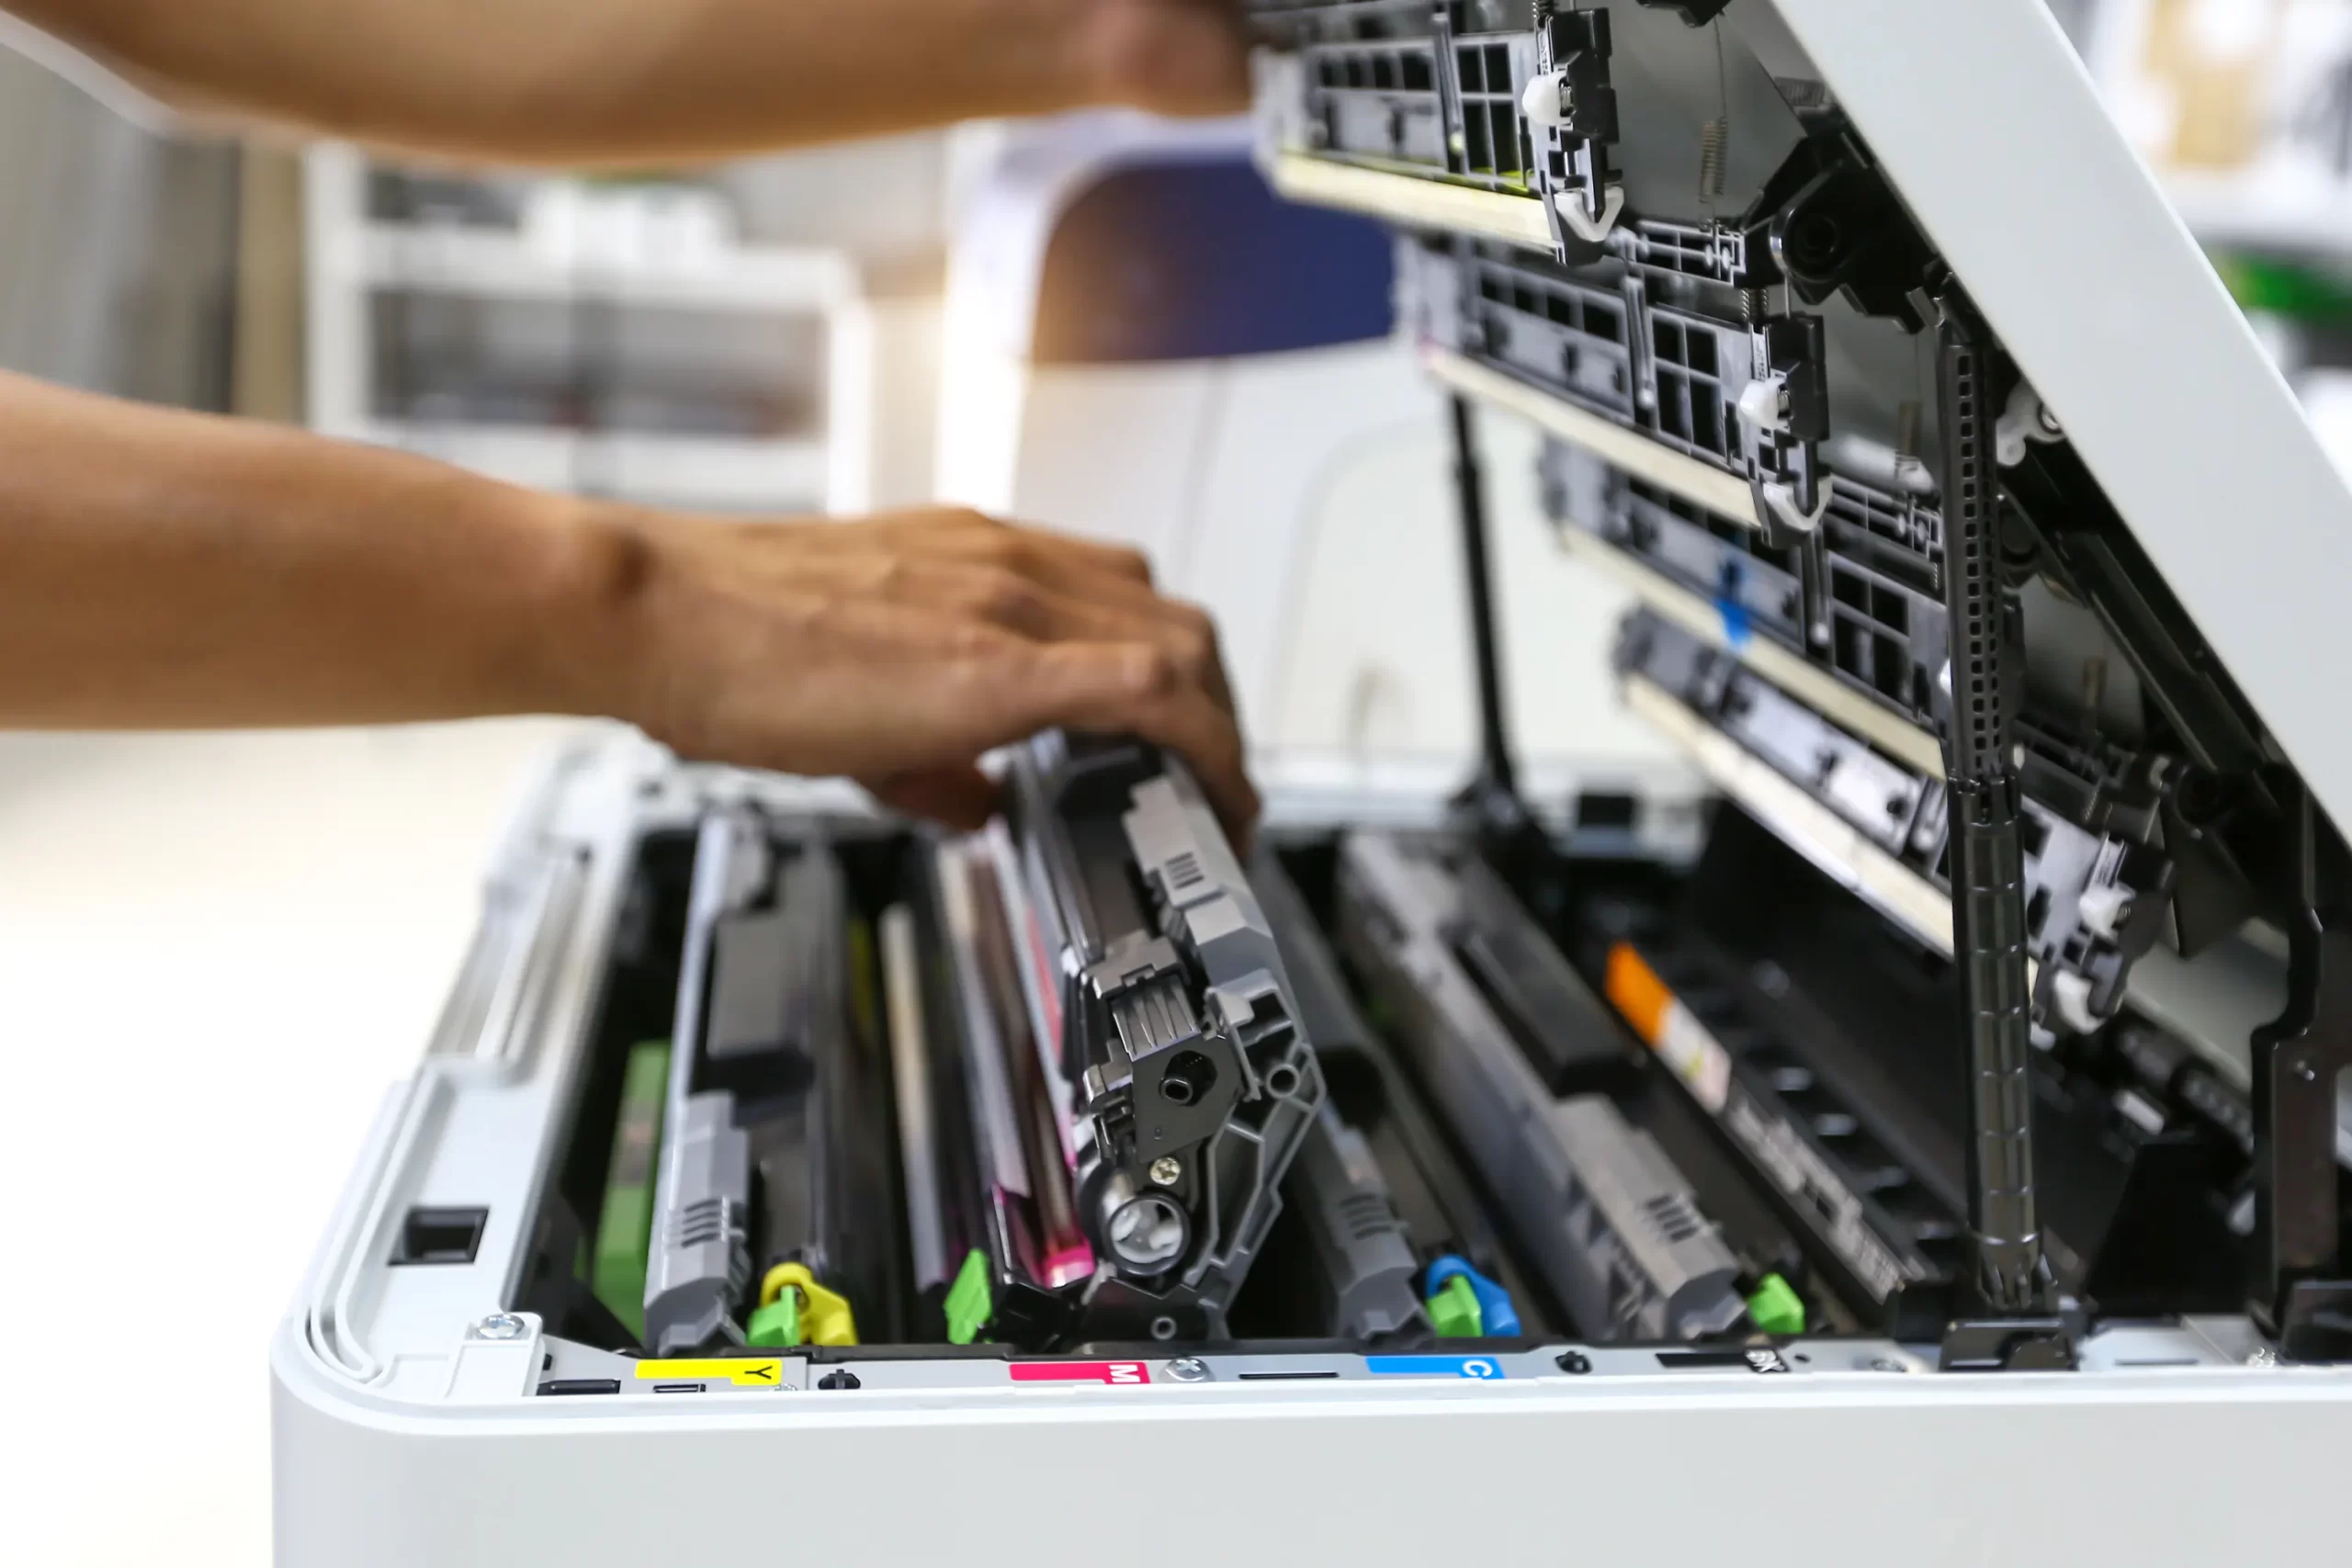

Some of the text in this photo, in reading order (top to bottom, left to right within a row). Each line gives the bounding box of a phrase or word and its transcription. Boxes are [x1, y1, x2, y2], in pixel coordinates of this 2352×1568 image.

[744, 1365, 773, 1380] Y
[1109, 1364, 1141, 1382] M
[1463, 1359, 1493, 1377] C
